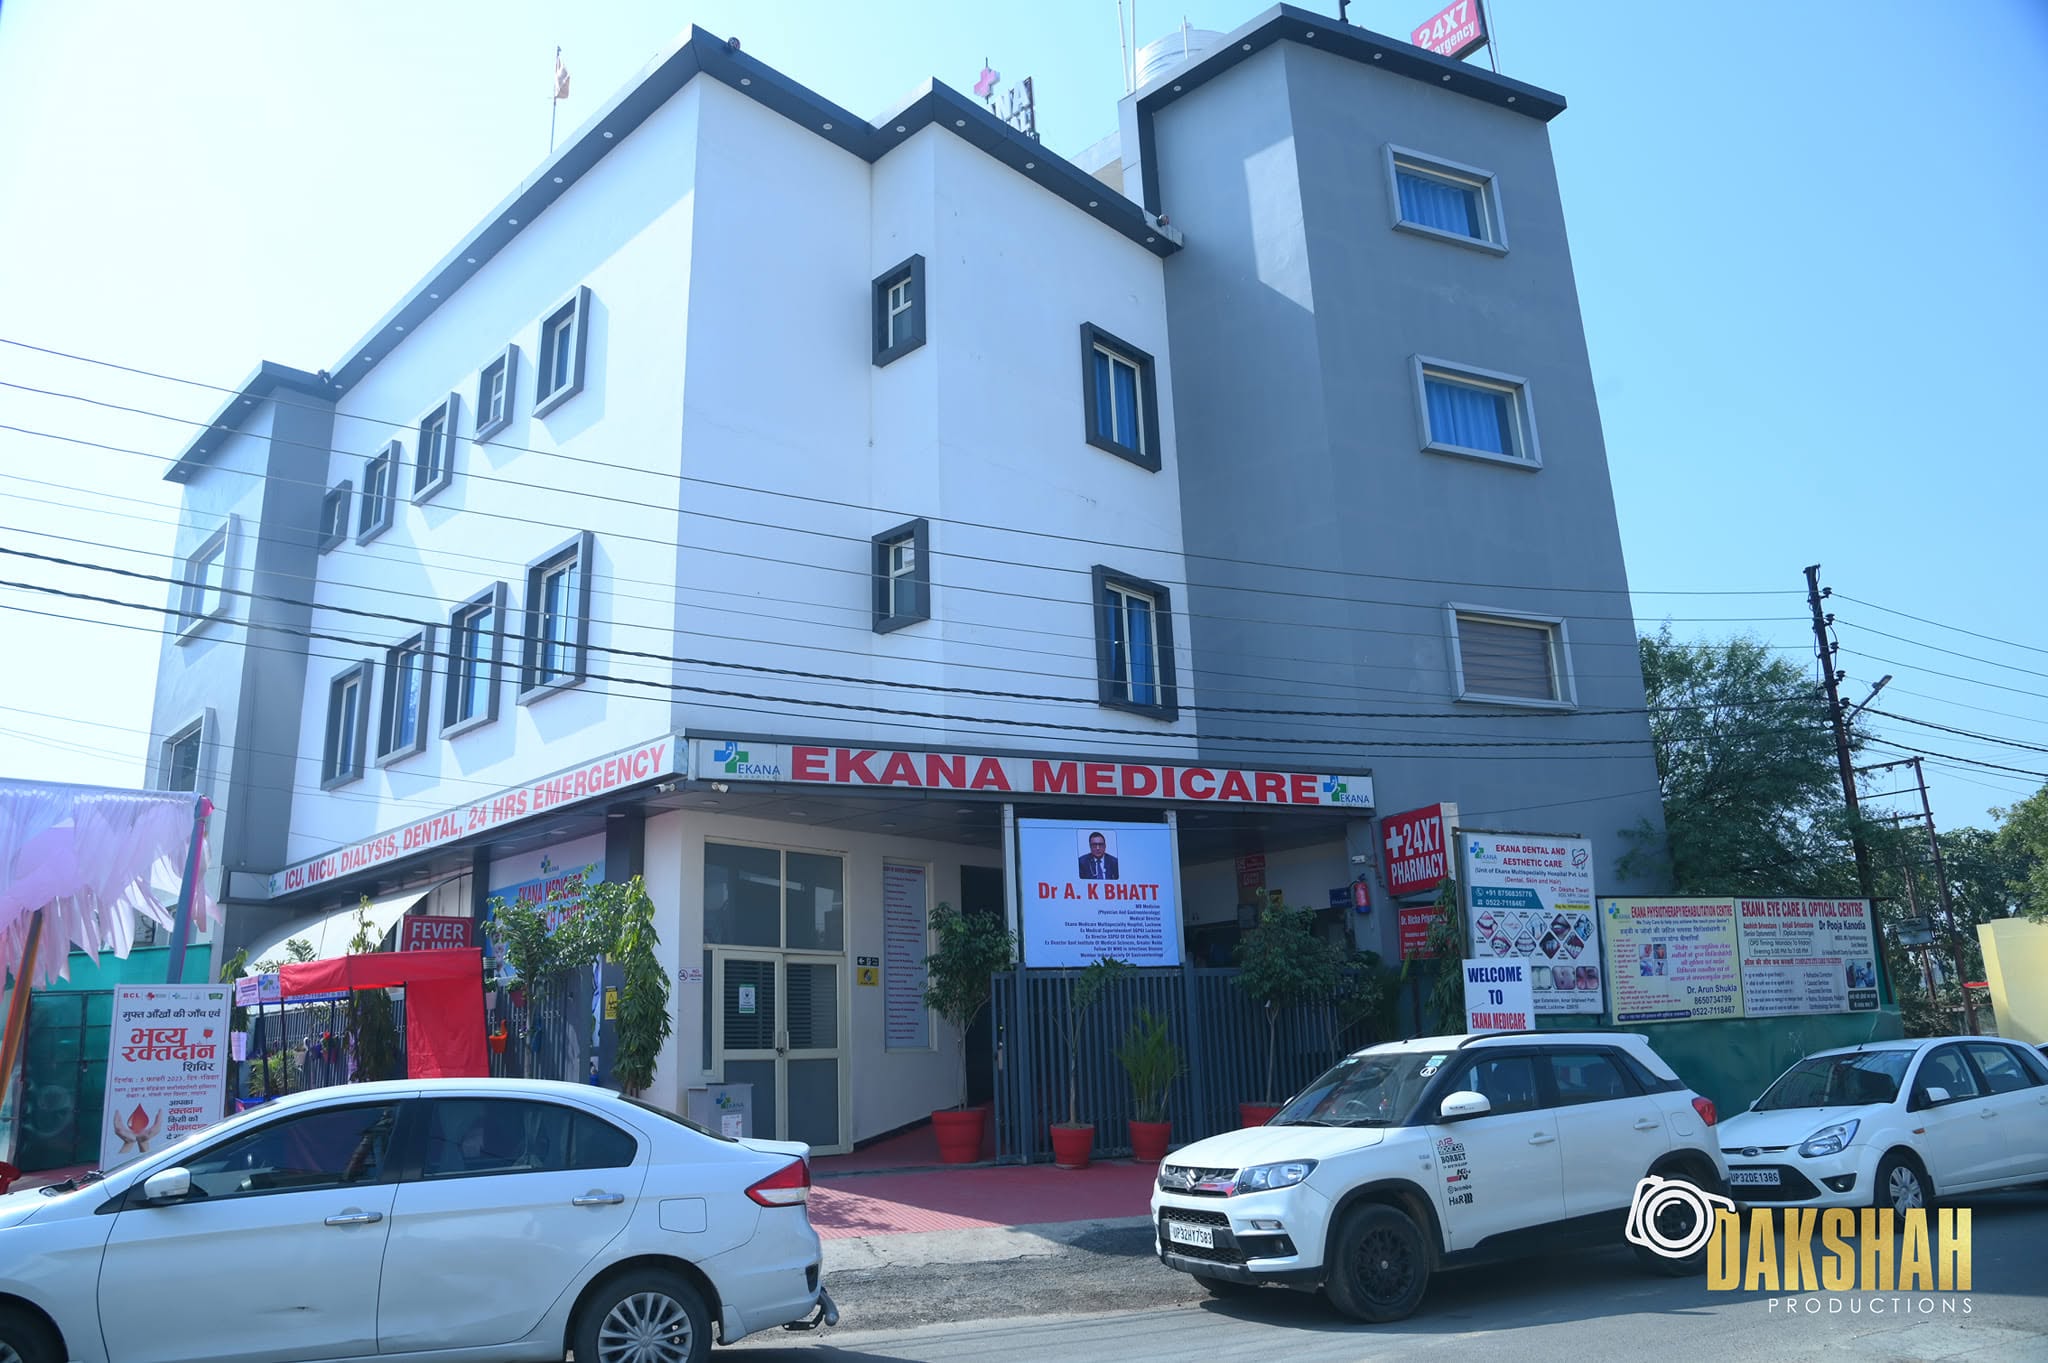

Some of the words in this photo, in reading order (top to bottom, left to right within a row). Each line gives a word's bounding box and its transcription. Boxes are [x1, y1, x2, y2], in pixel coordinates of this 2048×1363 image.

[738, 764, 780, 775] EKANA
[791, 746, 1011, 791] EKANA
[1032, 760, 1320, 805] MEDICARE
[1341, 793, 1370, 804] EKANA
[284, 870, 305, 891] ICU,
[307, 858, 337, 884] NICU,
[340, 834, 398, 872] DIALYSIS,
[402, 813, 463, 850] DENTAL,
[467, 803, 487, 831] 24
[492, 789, 528, 822] HRS
[532, 743, 666, 811] EMERGENCY
[1402, 816, 1441, 857] 24X7
[1496, 844, 1521, 853] EKANA
[1522, 846, 1549, 855] DENTAL
[1551, 847, 1566, 856] AND
[1391, 852, 1445, 886] PHARMACY
[1503, 858, 1542, 867] AESTHETIC
[1543, 860, 1563, 868] CARE
[1038, 882, 1057, 899] Dr
[1064, 882, 1081, 900] A.
[1088, 883, 1099, 900] K
[1104, 884, 1159, 900] BHATT
[1741, 901, 1766, 917] EKANA
[1766, 901, 1781, 917] EYE
[1782, 902, 1800, 917] CARE
[1808, 902, 1837, 918] OPTICAL
[1838, 902, 1864, 918] CENTRE
[411, 922, 464, 941] FEVER
[1827, 920, 1843, 932] Pooja
[1467, 966, 1523, 983] WELCOME
[1488, 989, 1504, 1005] TO
[1687, 986, 1697, 994] Dr.
[1471, 1012, 1492, 1030] EKANA
[1493, 1012, 1527, 1030] MEDICARE
[130, 1028, 188, 1046] भव्य
[121, 1044, 216, 1062] रक्तदान
[1440, 1152, 1466, 1164] BORBET
